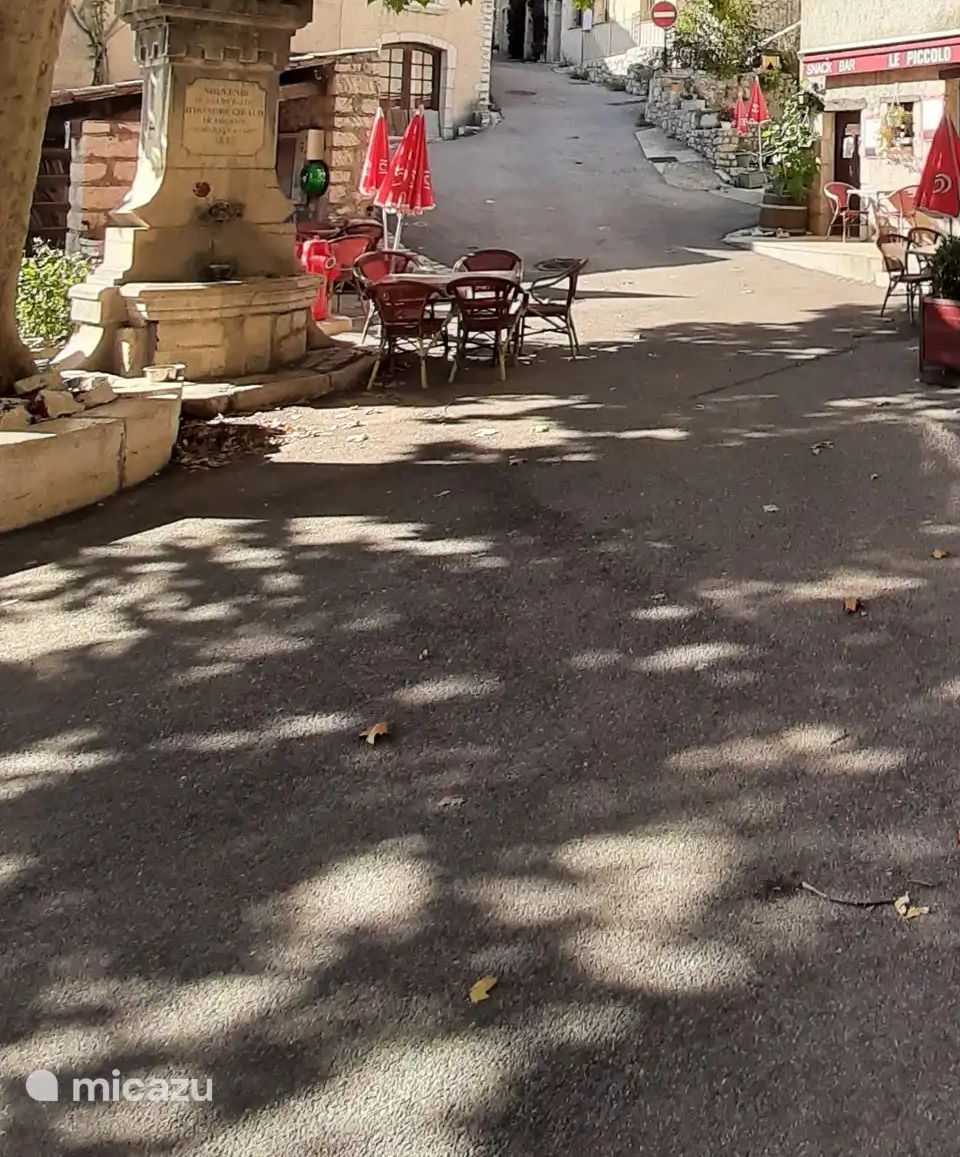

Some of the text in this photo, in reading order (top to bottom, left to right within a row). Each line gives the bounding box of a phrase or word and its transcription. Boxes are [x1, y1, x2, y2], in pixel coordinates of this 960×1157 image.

[888, 46, 952, 68] LE PICCOLO
[806, 59, 855, 76] SNACK BAR
